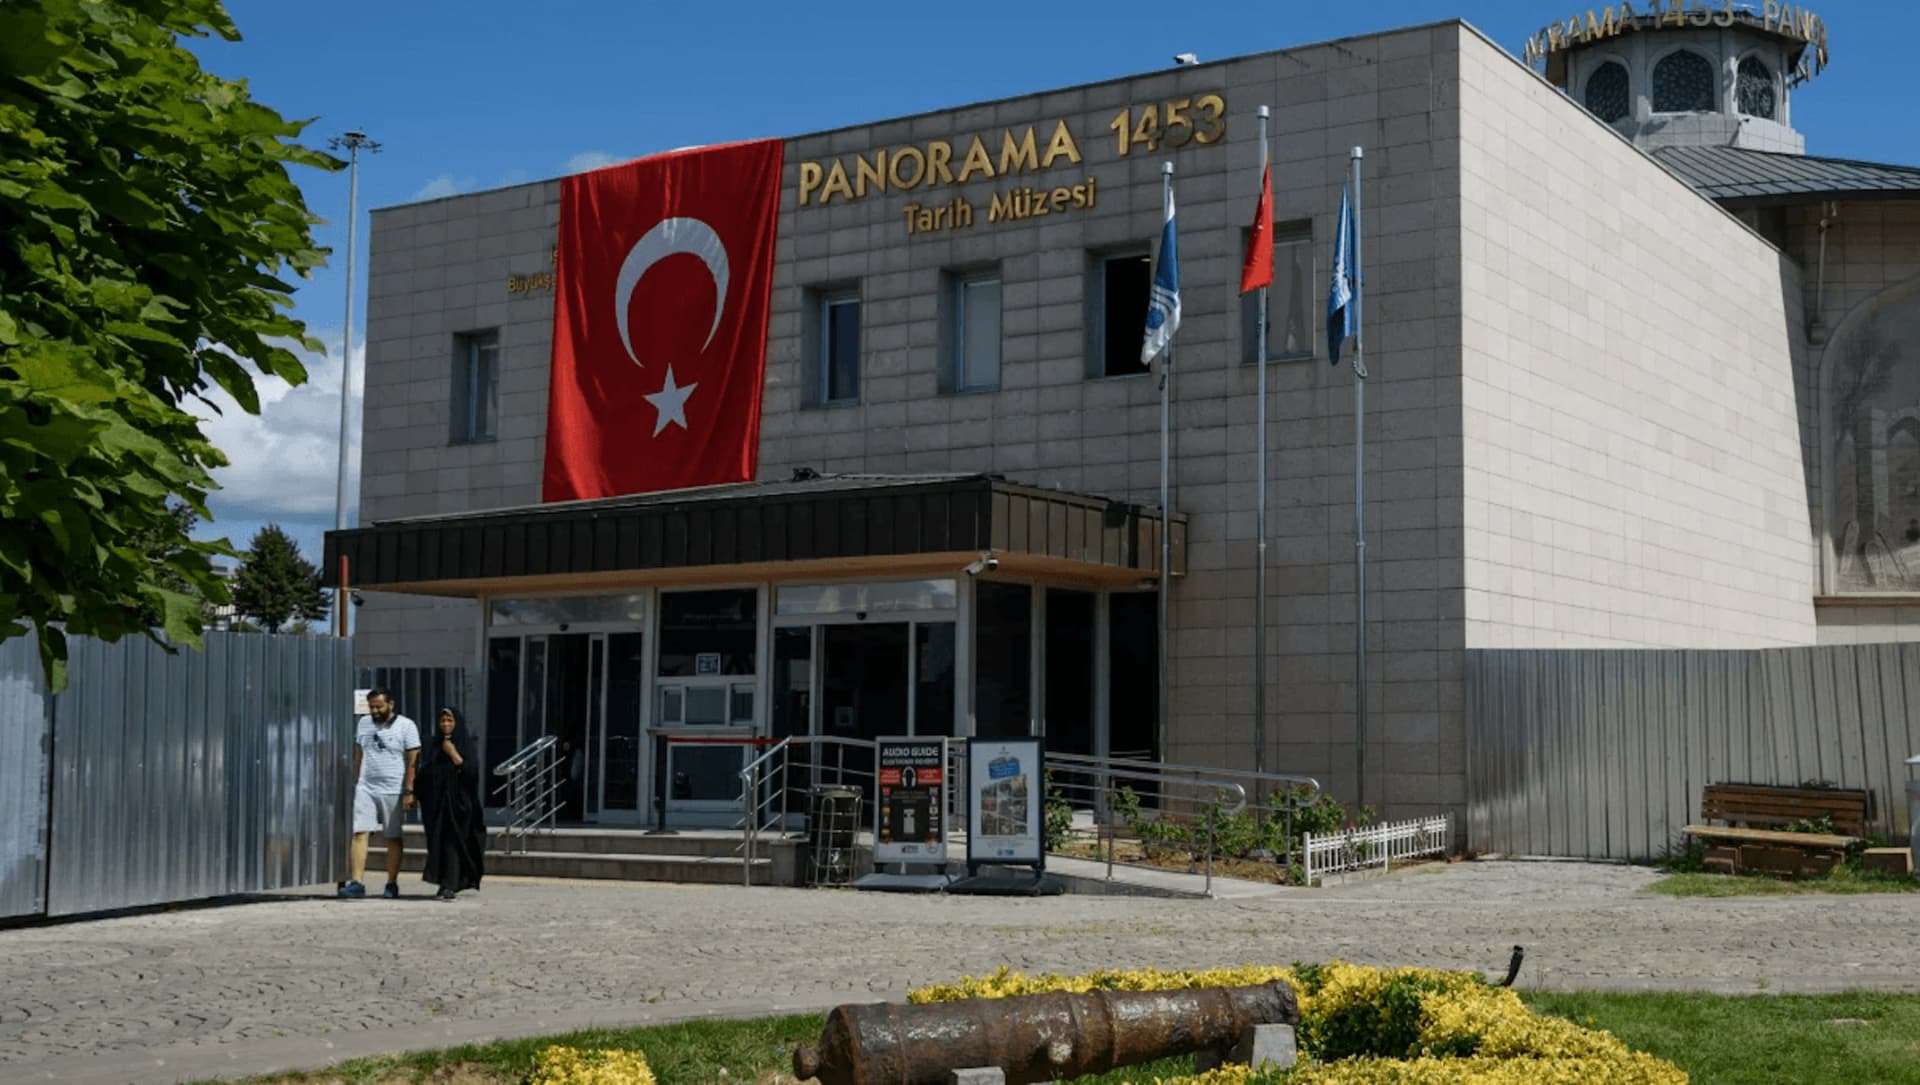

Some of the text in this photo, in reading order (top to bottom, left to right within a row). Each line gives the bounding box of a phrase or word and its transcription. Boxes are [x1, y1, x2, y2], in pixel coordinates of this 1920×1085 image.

[1647, 0, 1735, 29] 1453
[798, 94, 1227, 206] PANORAMA 1453
[903, 176, 1097, 235] Tarih Müzesi
[882, 746, 939, 757] AUDIO GUIDE
